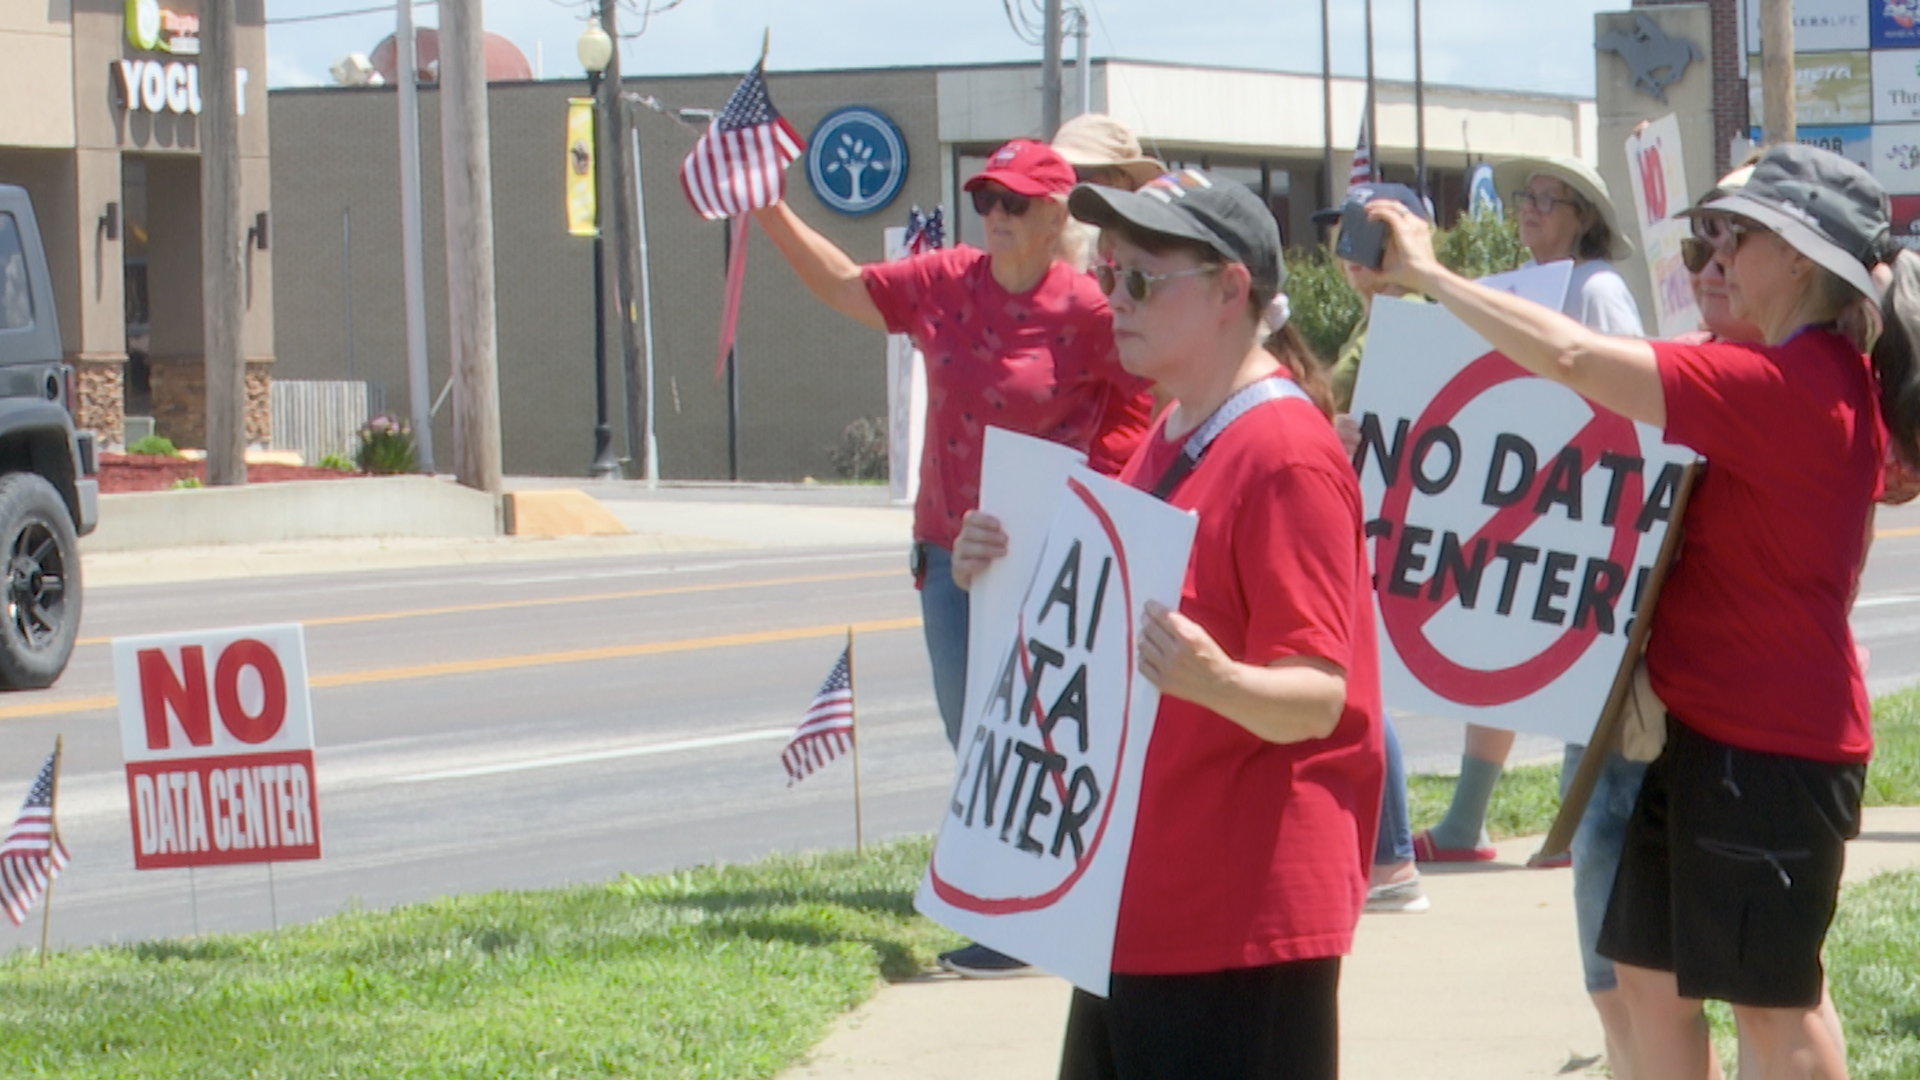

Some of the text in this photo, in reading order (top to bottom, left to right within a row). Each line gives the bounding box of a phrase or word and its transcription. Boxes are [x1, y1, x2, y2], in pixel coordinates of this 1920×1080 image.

[121, 59, 249, 115] YOGUT
[1352, 411, 1685, 533] NO DATA
[1037, 538, 1112, 652] AI
[136, 638, 287, 750] NO
[986, 630, 1089, 754] ATA
[134, 762, 315, 856] DATA CENTER
